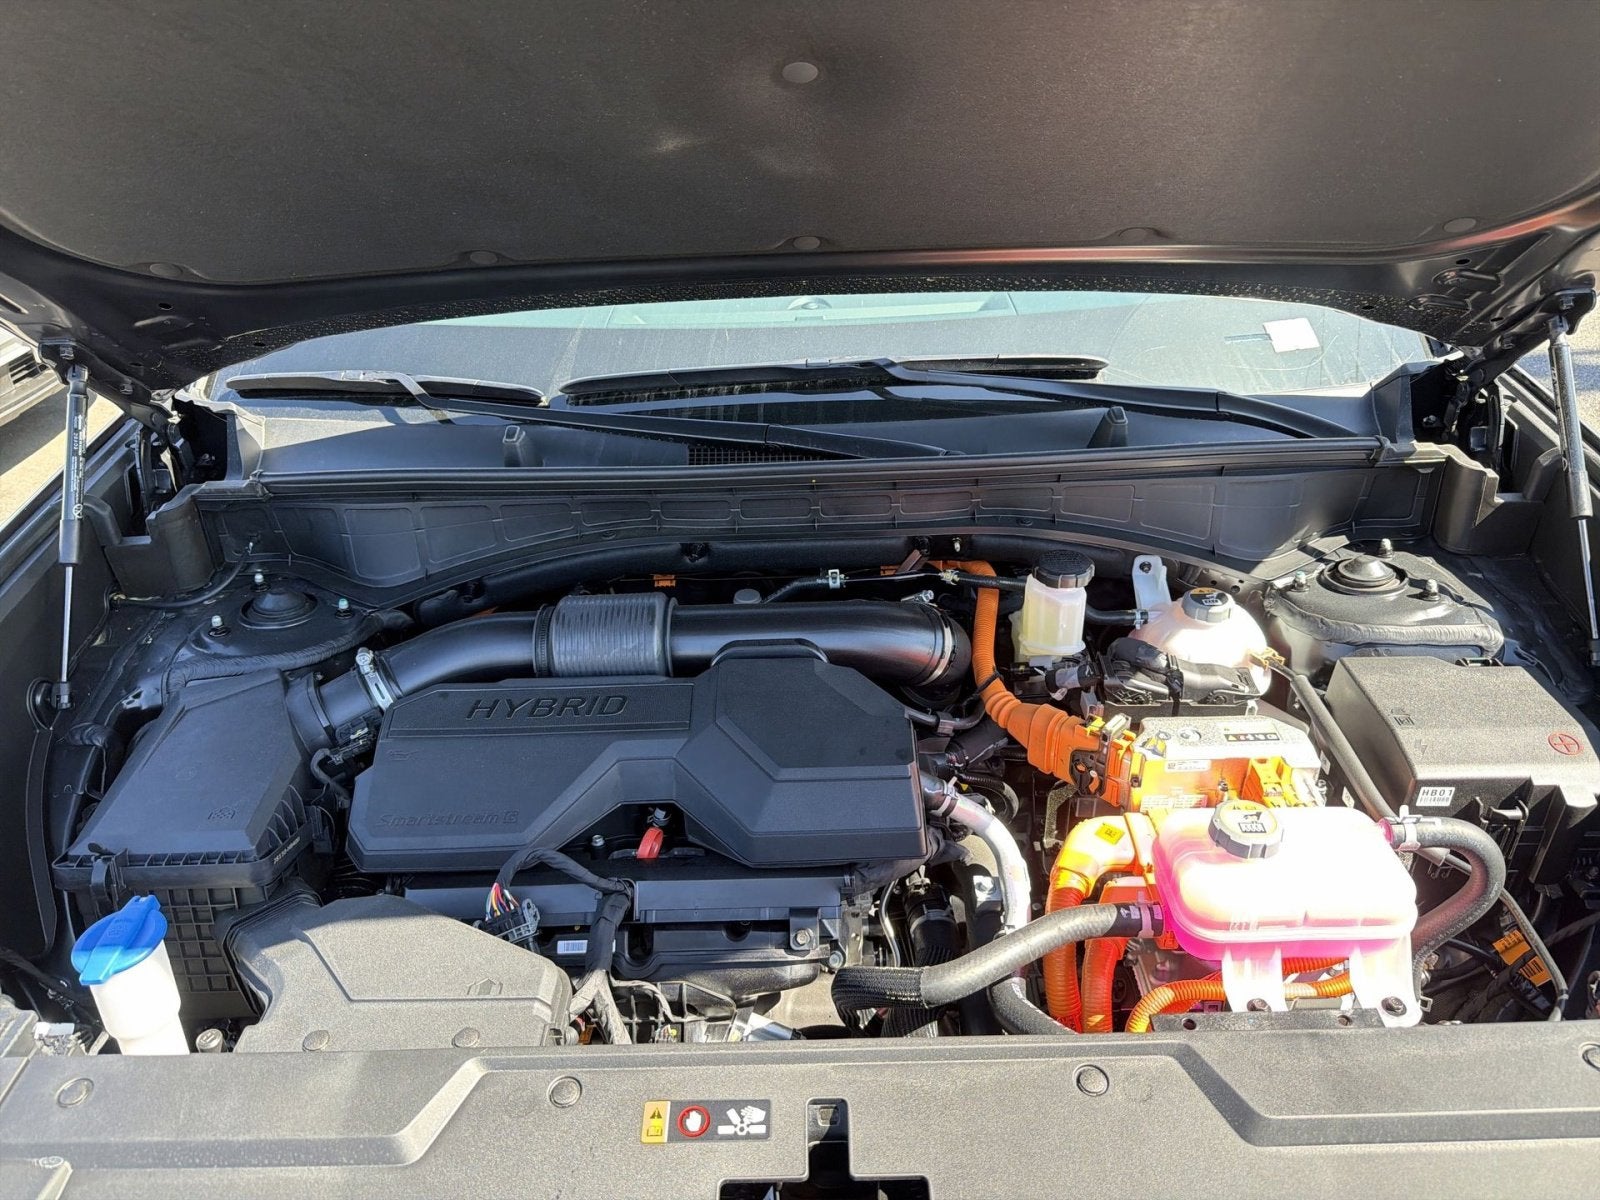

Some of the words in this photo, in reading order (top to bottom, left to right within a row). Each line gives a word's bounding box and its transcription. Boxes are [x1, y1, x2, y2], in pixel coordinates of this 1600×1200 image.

[465, 695, 629, 720] HYBRID
[1421, 789, 1453, 797] HB01
[377, 811, 500, 828] Smartstream
